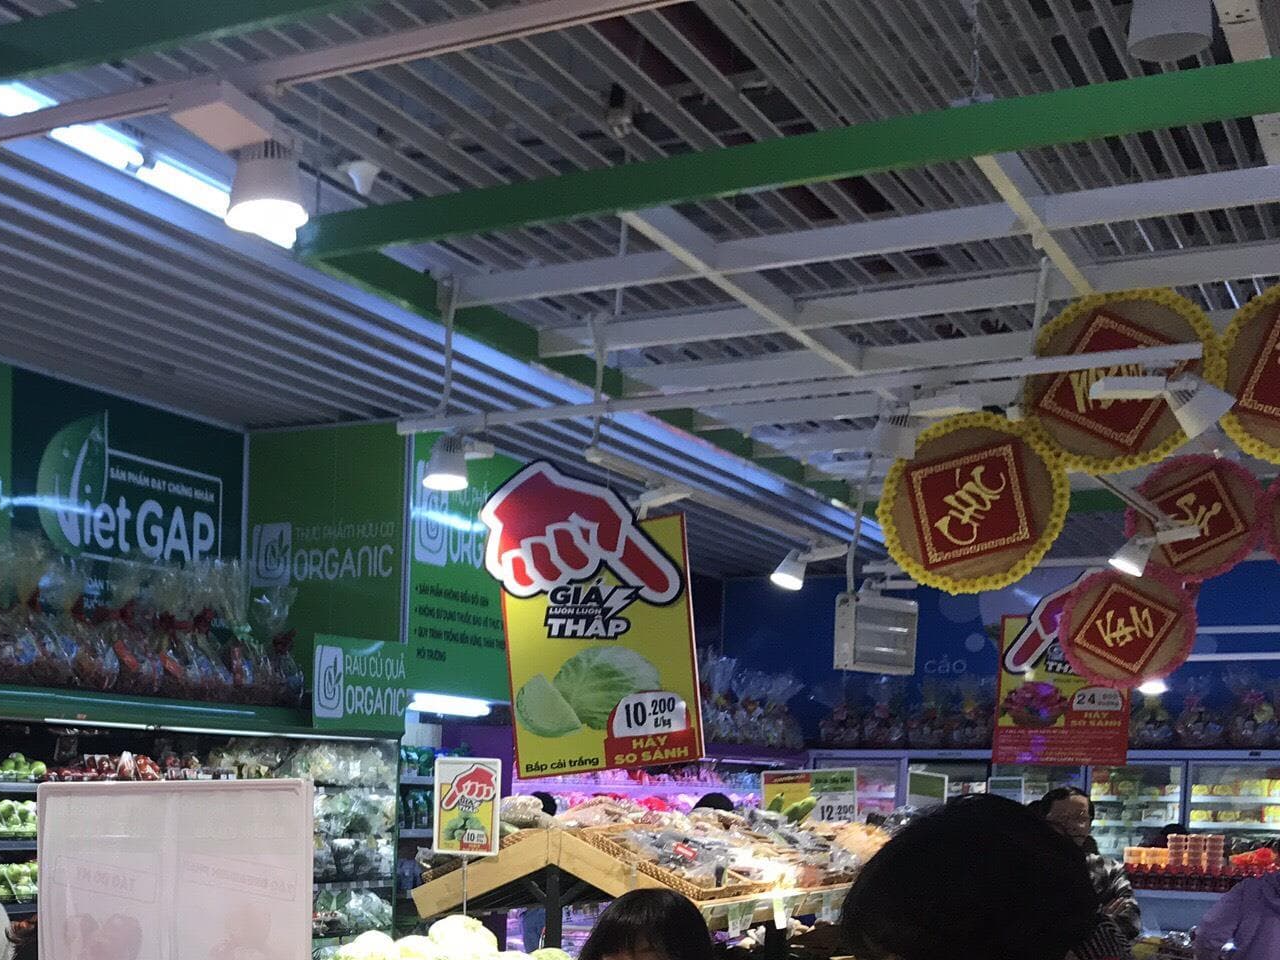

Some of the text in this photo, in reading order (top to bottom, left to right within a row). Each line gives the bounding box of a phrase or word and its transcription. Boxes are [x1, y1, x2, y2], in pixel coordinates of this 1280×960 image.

[293, 543, 394, 581] ORGANIC
[549, 578, 605, 606] GIÁ
[345, 654, 367, 677] RAU
[345, 684, 406, 717] ORGANIC
[525, 760, 548, 774] Bắp
[614, 746, 689, 765] SO SÁNH
